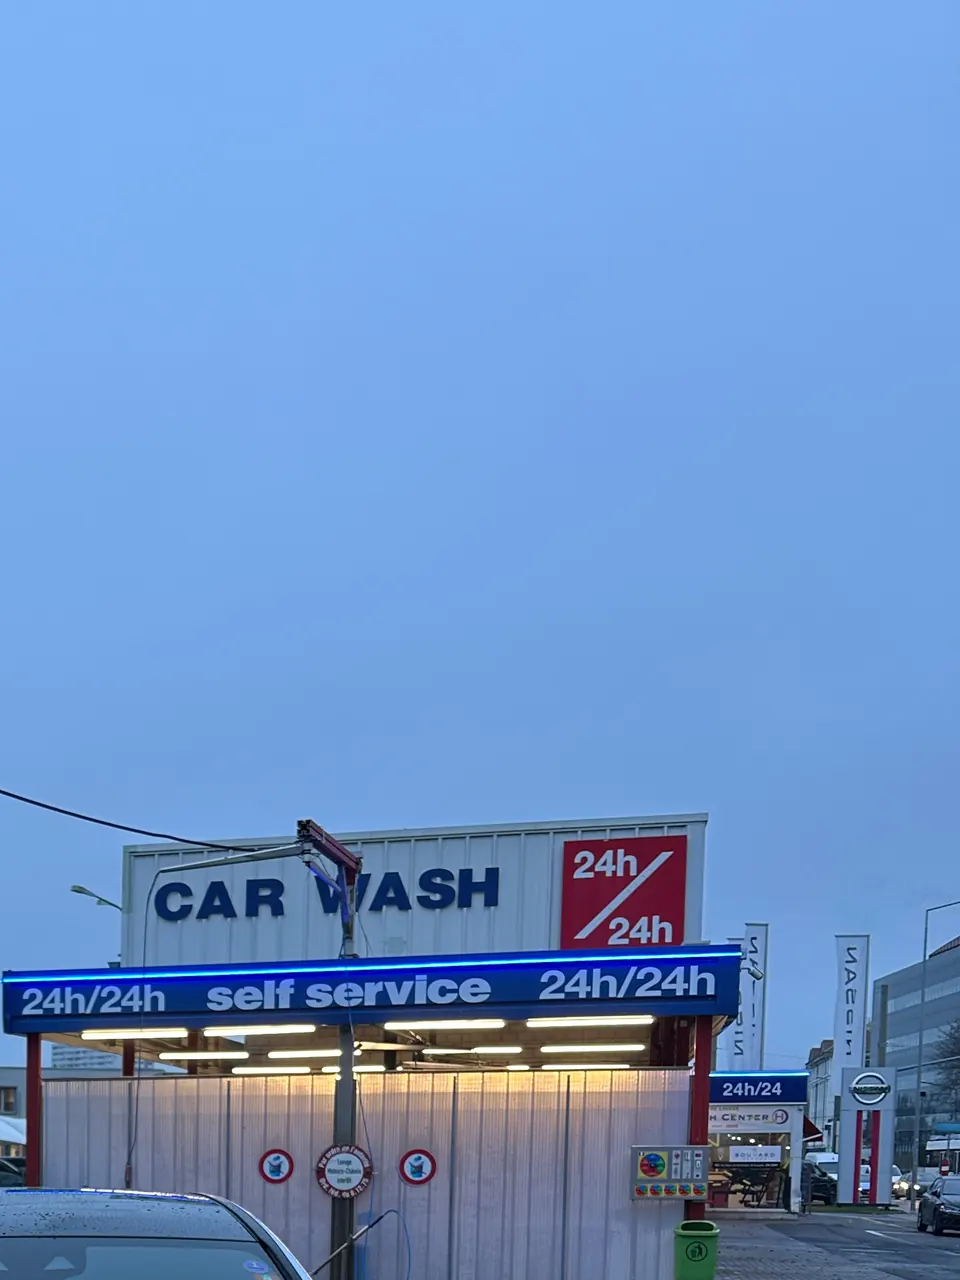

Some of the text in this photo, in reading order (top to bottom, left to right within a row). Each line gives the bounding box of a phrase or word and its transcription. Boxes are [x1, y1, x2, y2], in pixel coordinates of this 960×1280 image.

[573, 848, 638, 879] 24h
[154, 866, 500, 921] CAR WASH
[607, 915, 673, 945] 24h
[22, 965, 716, 1015] 24h/24h self service 24h/24h
[722, 1082, 783, 1096] 24h/24
[721, 1113, 769, 1122] CENTER
